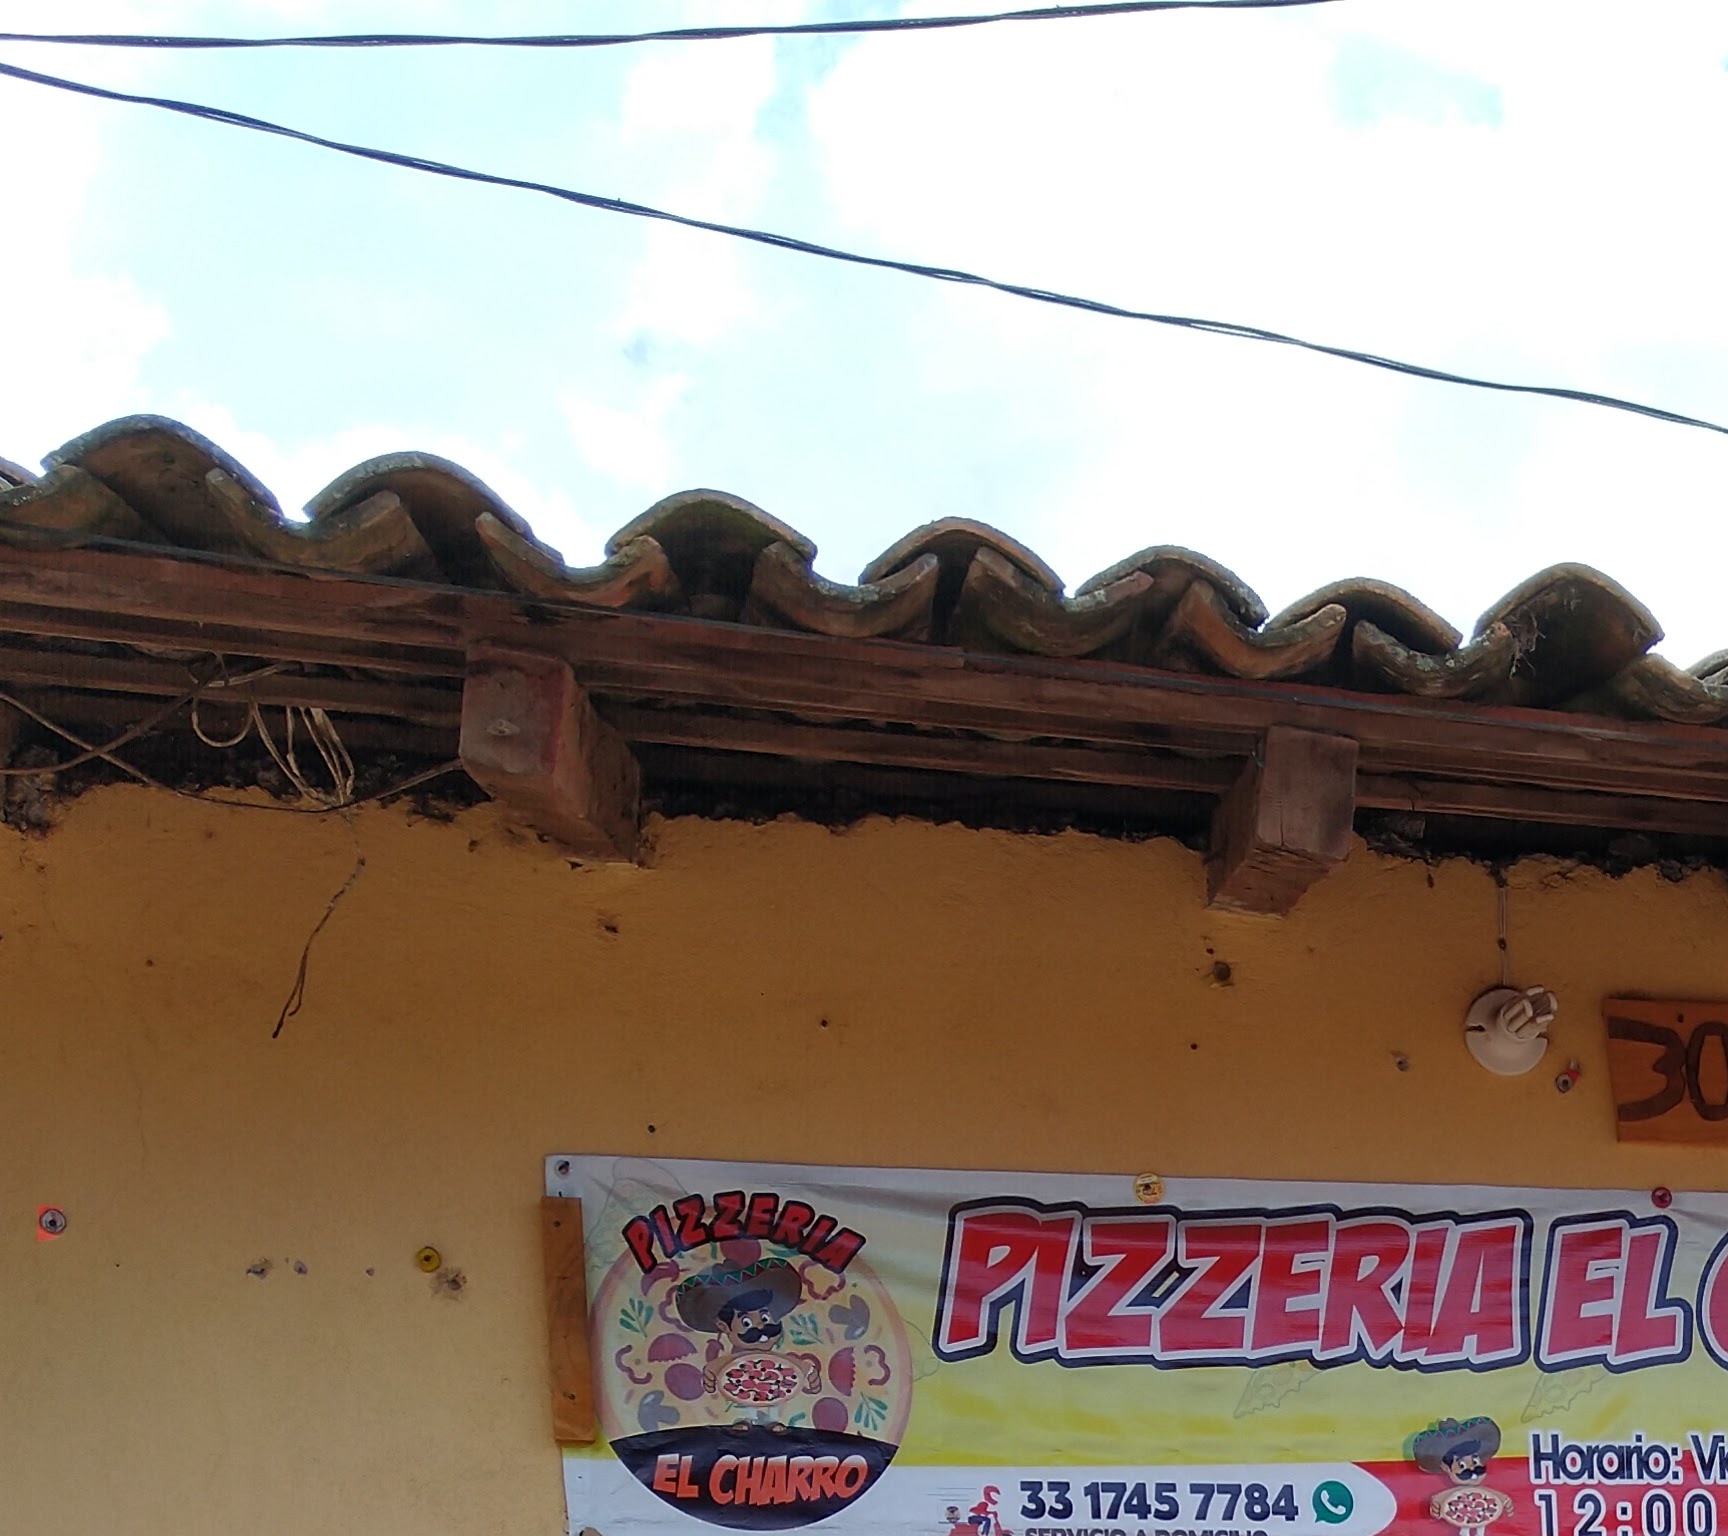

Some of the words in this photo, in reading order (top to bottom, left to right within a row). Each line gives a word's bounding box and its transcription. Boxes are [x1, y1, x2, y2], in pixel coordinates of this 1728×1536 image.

[621, 1190, 867, 1275] PIZZERIA
[933, 1195, 1531, 1376] PIZZERIA
[1537, 1211, 1693, 1375] EL
[652, 1454, 699, 1497] EL
[709, 1452, 870, 1506] CHARRO
[1530, 1432, 1682, 1483] Horario:
[1020, 1481, 1074, 1521] 33
[1083, 1482, 1180, 1522] 1745
[1197, 1483, 1300, 1523] 7784
